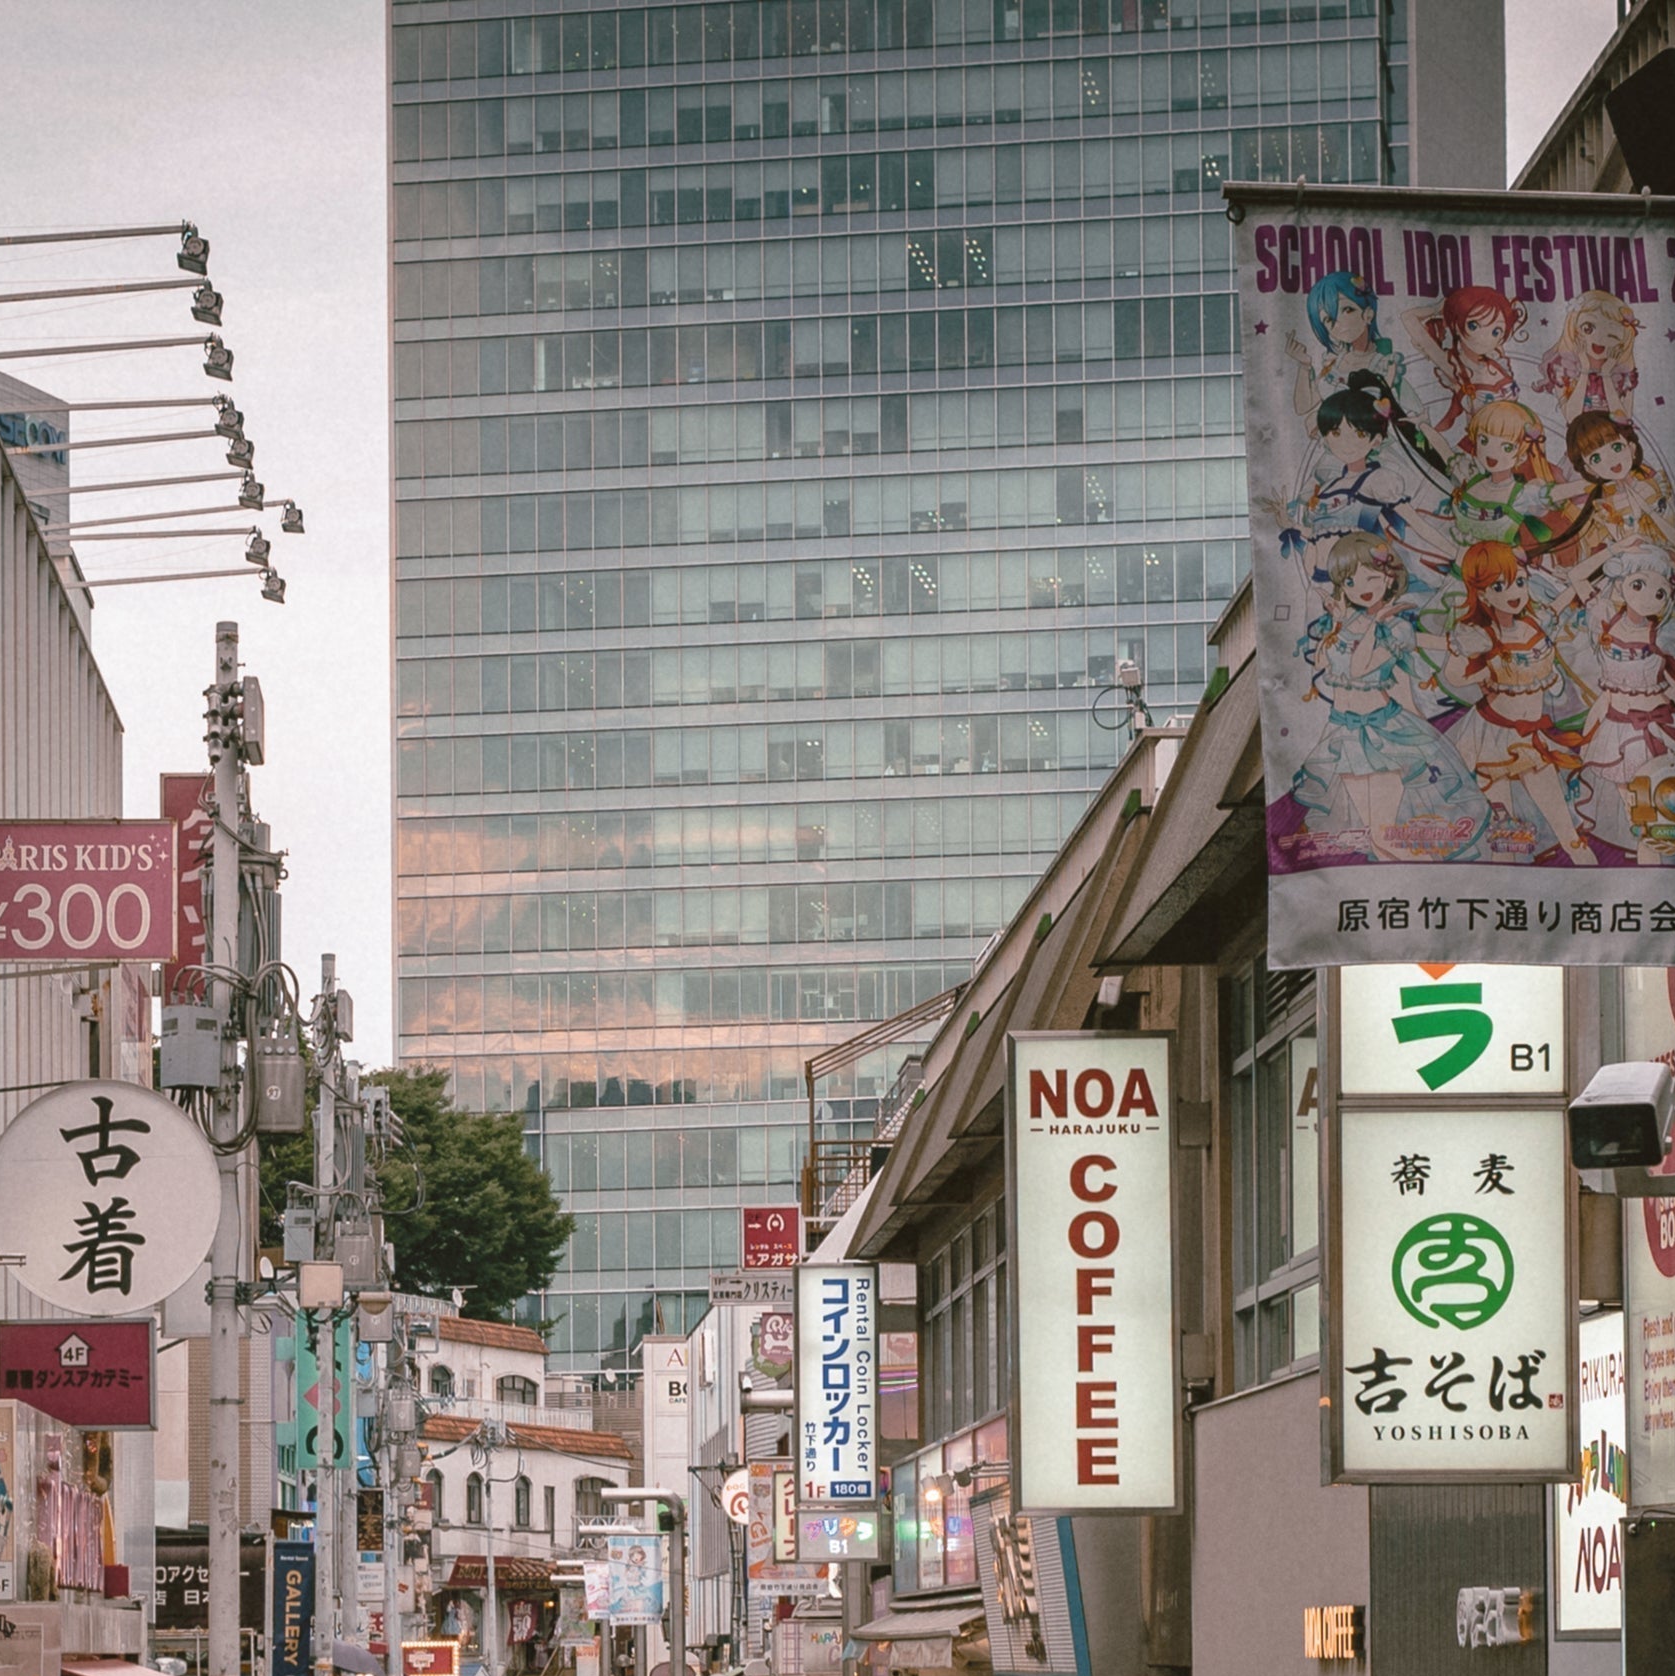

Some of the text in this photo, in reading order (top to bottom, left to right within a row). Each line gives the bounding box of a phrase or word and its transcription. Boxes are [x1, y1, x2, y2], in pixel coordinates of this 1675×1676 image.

[1255, 224, 1393, 297] SCHOOL
[1404, 230, 1474, 298] IDOL
[1494, 236, 1658, 303] FESTIVAL
[76, 843, 154, 872] KID'S
[1511, 1044, 1551, 1073] B1
[1029, 1067, 1160, 1119] NOA
[1049, 1124, 1142, 1135] HARAJUKU
[59, 1097, 151, 1297] 古着
[1391, 1153, 1515, 1197] 蕎麦
[1068, 1155, 1121, 1486] COFFEE
[1643, 1317, 1660, 1339] Fresh
[5, 1369, 144, 1390] 原宿ダンスアカデミー
[63, 1347, 85, 1363] 4F
[822, 1278, 851, 1472] コインロッカー
[856, 1278, 871, 1472] Rental Coin Locker
[1582, 1351, 1625, 1403] RIKURA
[1346, 1347, 1547, 1416] 吉そば
[805, 1422, 817, 1472] 竹下通り
[1373, 1425, 1530, 1441] YOSHISOBA
[805, 1481, 825, 1498] 1F
[829, 1540, 848, 1554] B1
[1575, 1524, 1622, 1594] NOA
[285, 1569, 302, 1666] GALLERY
[810, 1631, 842, 1645] HARAJ
[1304, 1605, 1355, 1659] NOA COFFEE
